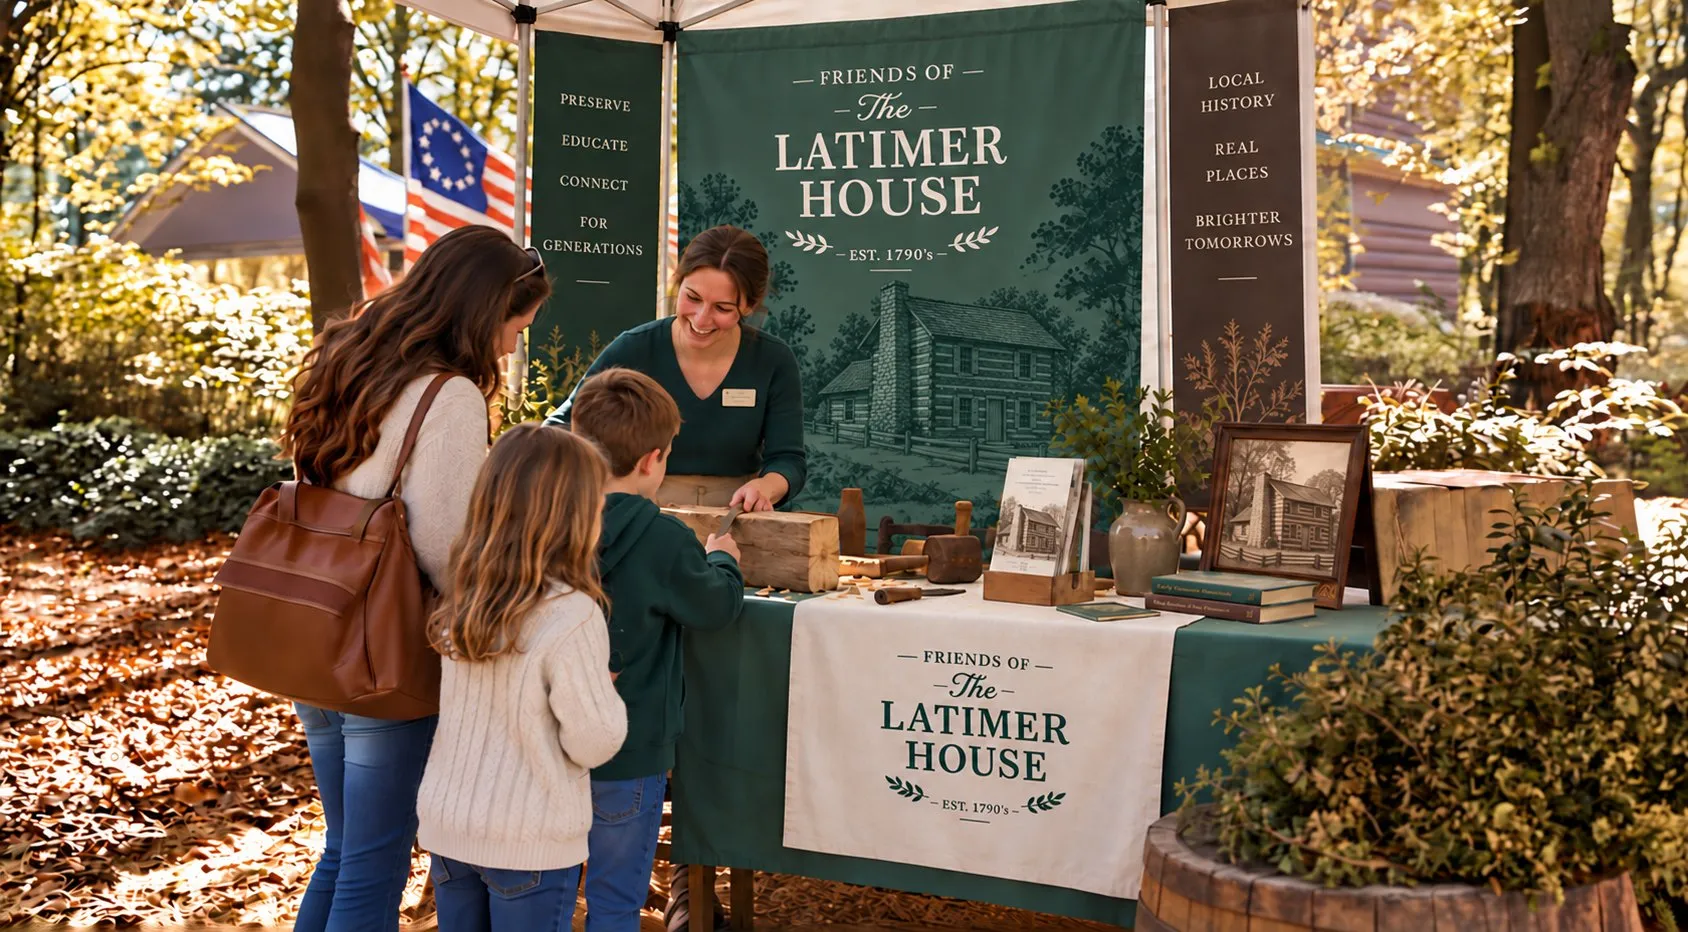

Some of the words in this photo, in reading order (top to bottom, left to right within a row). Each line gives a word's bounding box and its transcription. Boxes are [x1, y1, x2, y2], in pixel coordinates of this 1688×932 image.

[820, 66, 917, 86] FRIENDS
[924, 63, 954, 81] OF
[1208, 71, 1265, 90] LOCAL
[560, 92, 631, 113] PRESERVE
[857, 91, 913, 121] The
[1201, 93, 1275, 113] HISTORY
[561, 134, 628, 152] EDUCATE
[775, 125, 1008, 171] LATIMER
[1215, 140, 1259, 156] REAL
[559, 174, 629, 192] CONNECT
[1206, 166, 1269, 183] PLACES
[799, 175, 981, 218] HOUSE
[580, 215, 608, 230] FOR
[1195, 210, 1281, 228] BRIGHTER
[542, 238, 643, 256] GENERATIONS
[1184, 233, 1293, 250] TOMORROWS
[849, 249, 881, 262] EST.
[886, 248, 934, 261] 1790's
[923, 650, 1002, 668] FRIENDS
[1007, 656, 1030, 671] OF
[949, 672, 998, 700] The
[880, 699, 1071, 746] LATIMER
[904, 740, 1047, 783] HOUSE
[942, 799, 969, 813] EST.
[973, 802, 1010, 816] 1790's
